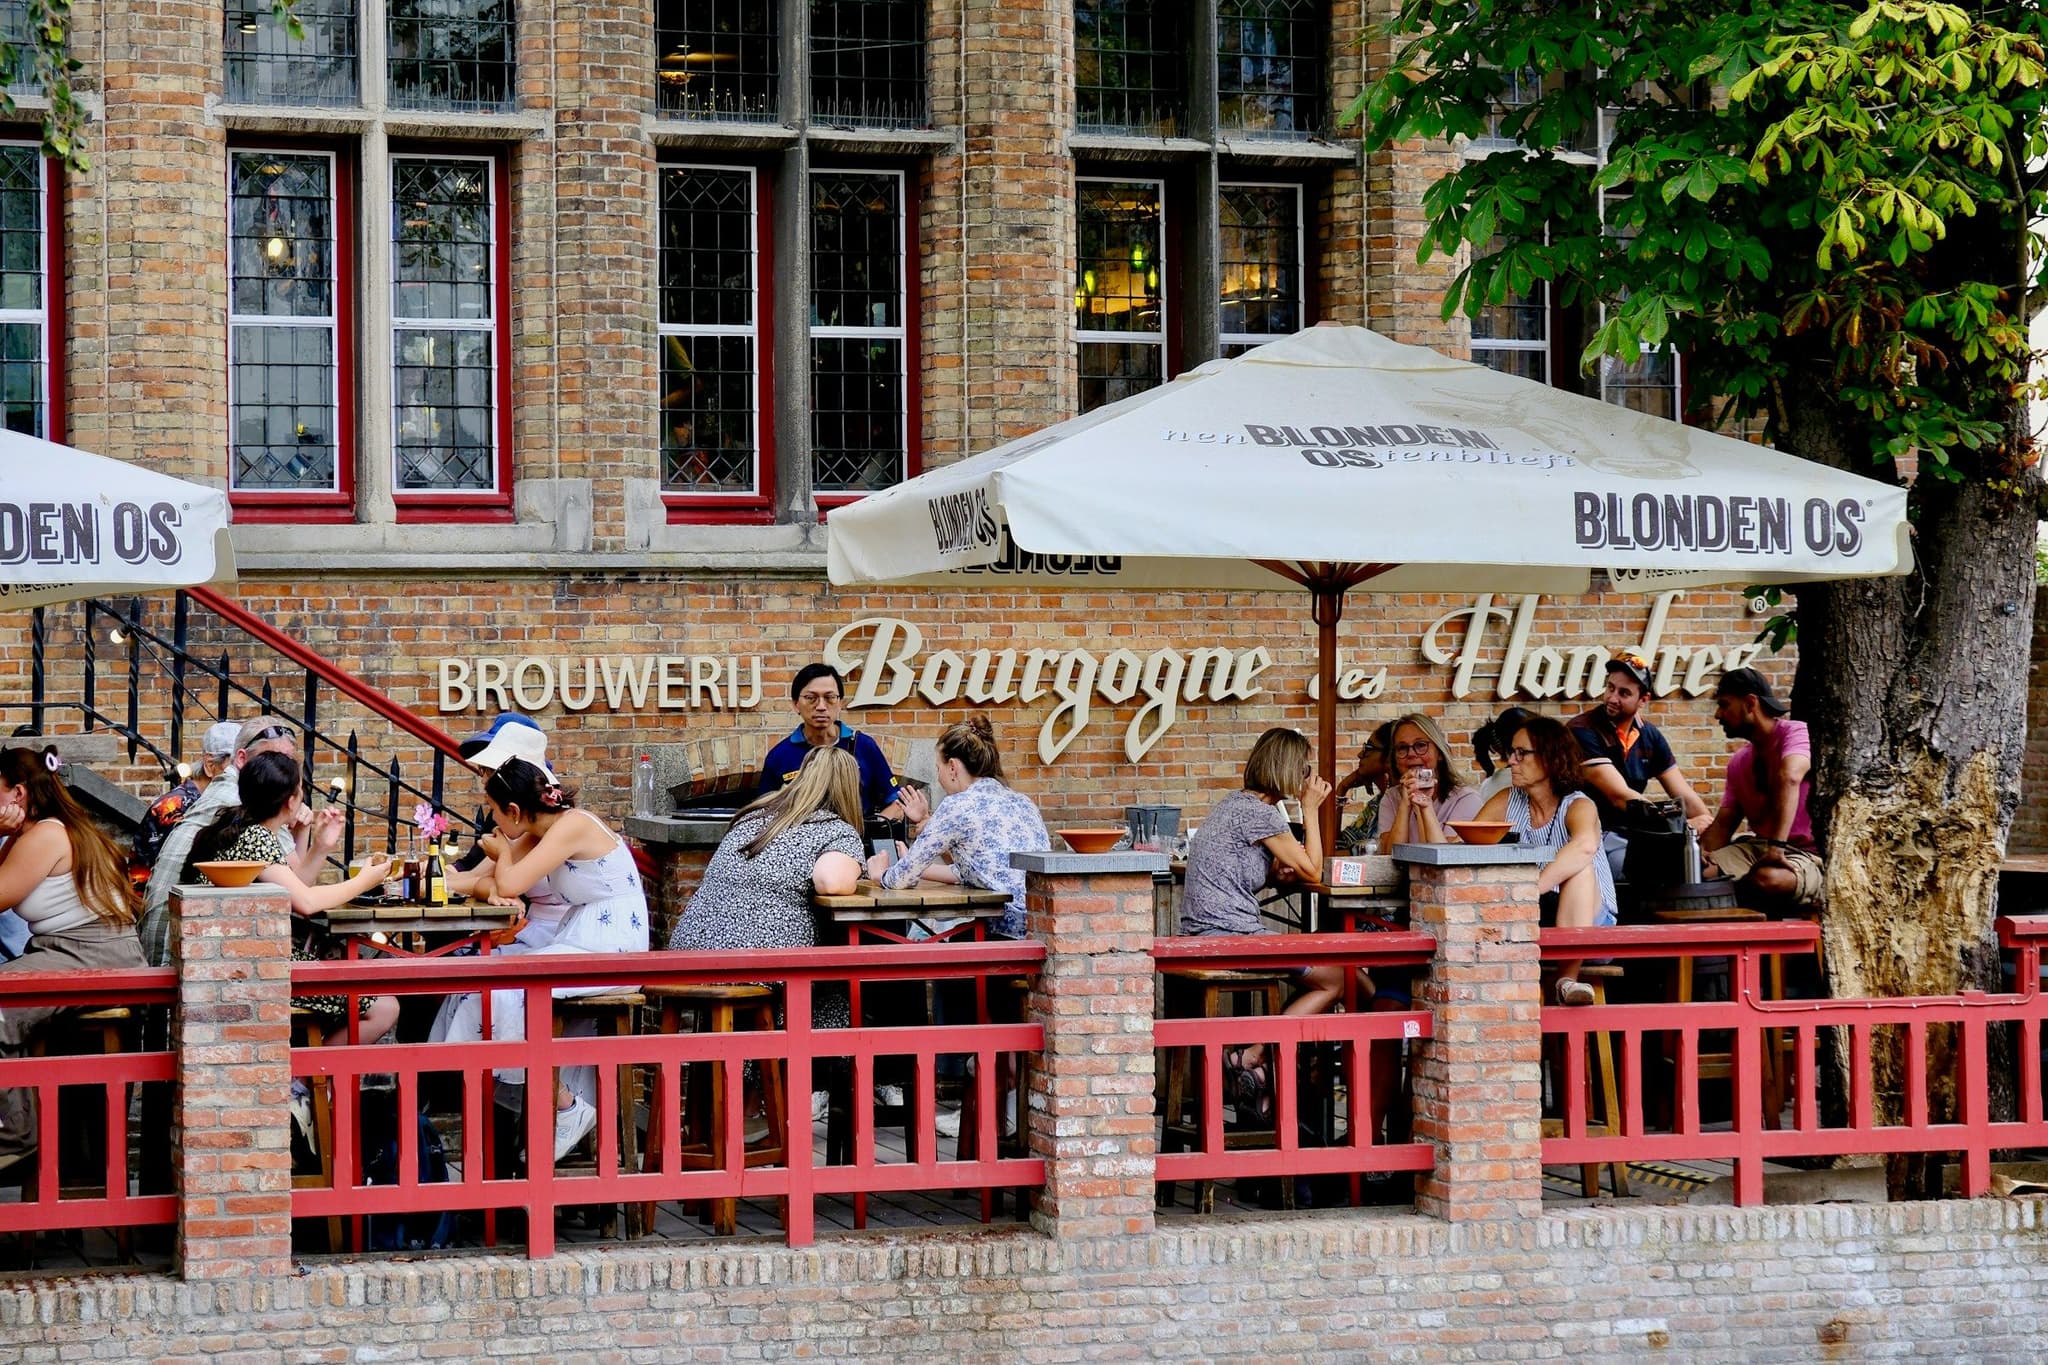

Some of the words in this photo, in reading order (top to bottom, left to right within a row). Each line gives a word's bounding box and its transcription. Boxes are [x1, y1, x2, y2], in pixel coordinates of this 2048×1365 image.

[1244, 424, 1500, 450] BLONDEN
[1300, 449, 1384, 469] OS
[0, 502, 100, 565] DEN
[928, 491, 977, 554] BLONDEN
[1574, 492, 1792, 554] BLONDEN
[438, 655, 762, 711] BROUWERIJ
[823, 617, 1273, 765] Bourgogne
